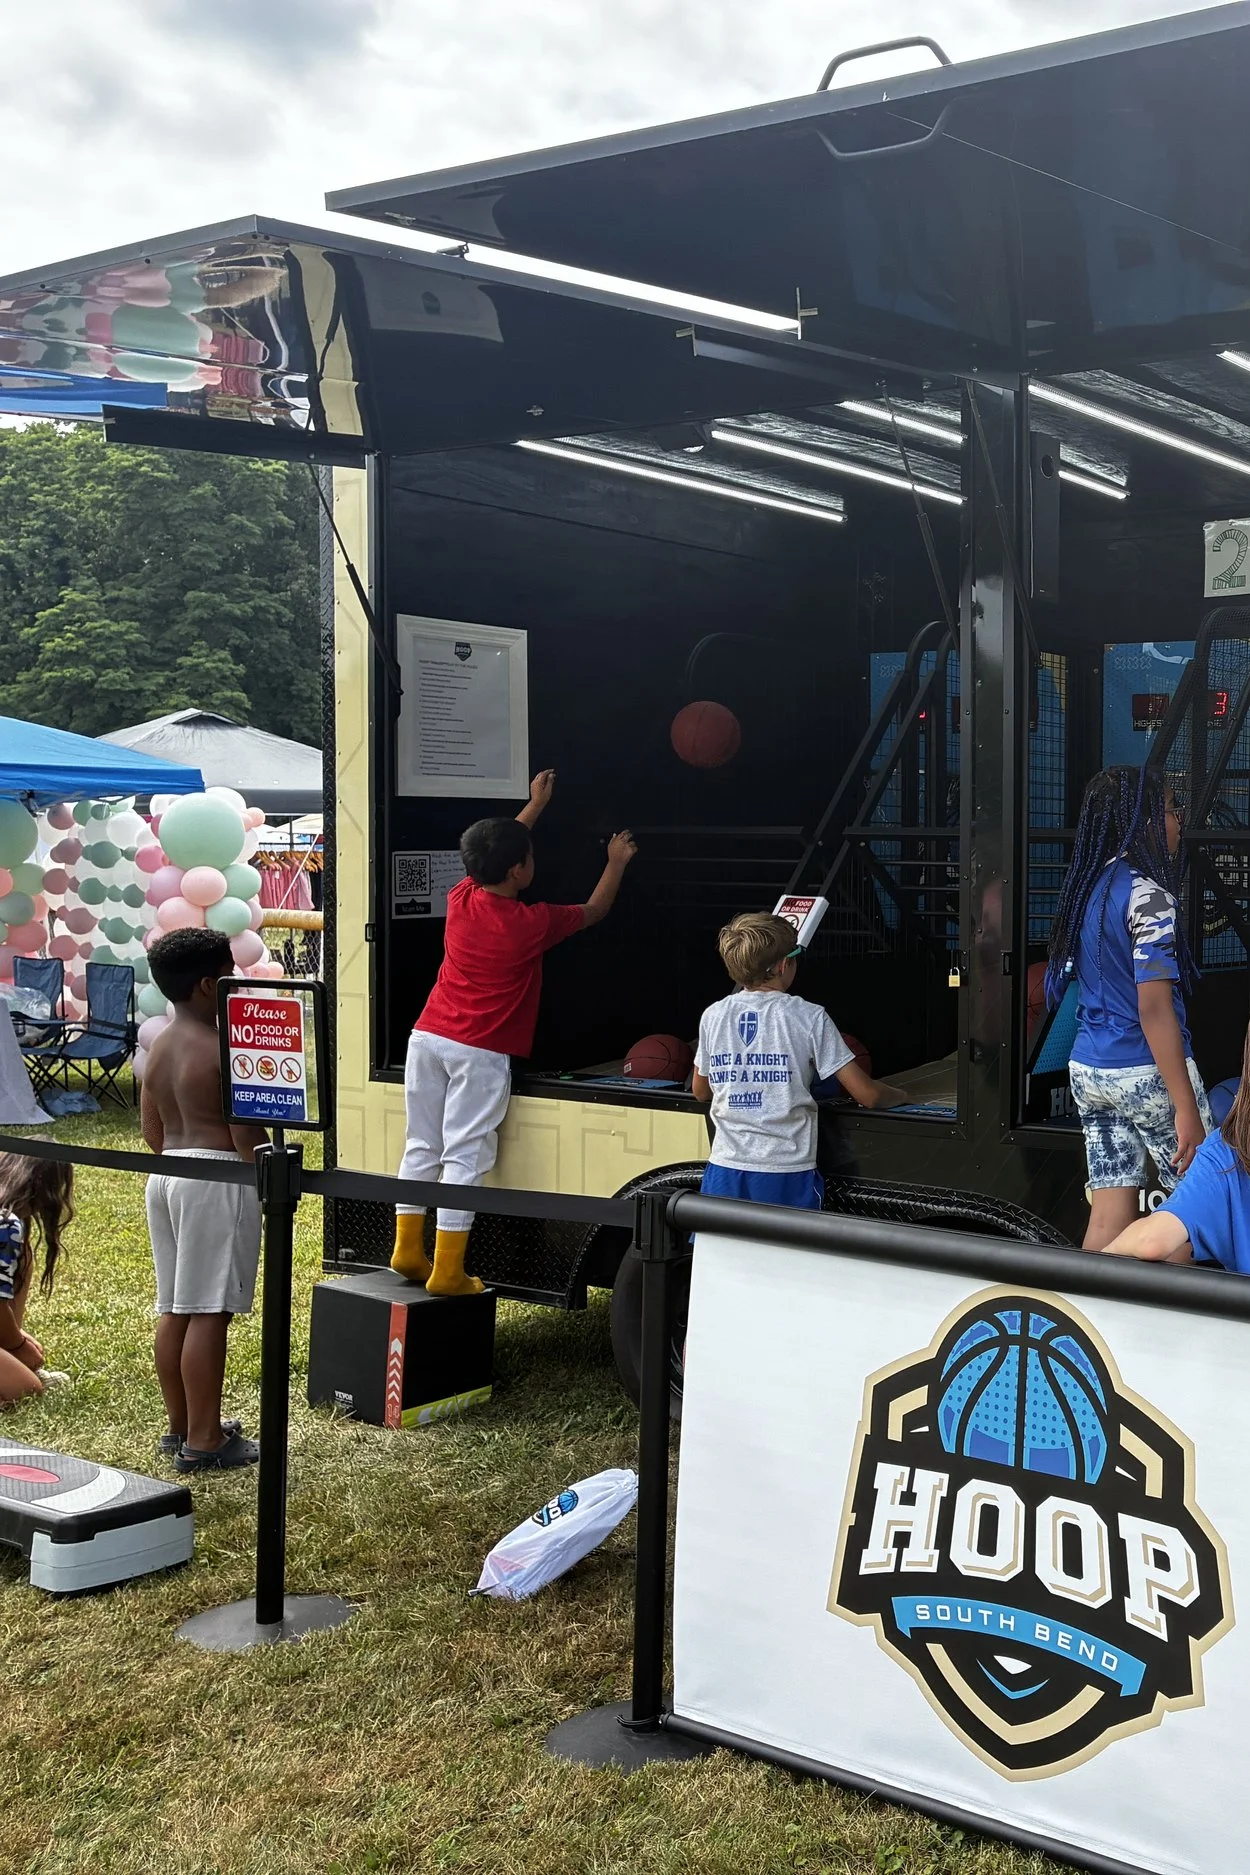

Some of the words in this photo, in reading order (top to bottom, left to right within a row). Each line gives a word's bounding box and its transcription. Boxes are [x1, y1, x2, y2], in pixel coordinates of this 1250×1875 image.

[1212, 528, 1248, 590] 2
[243, 1002, 288, 1020] Please
[231, 1023, 254, 1044] NO
[254, 1024, 282, 1036] FOOD
[284, 1026, 299, 1037] OR
[255, 1036, 292, 1048] DRINKS
[710, 1053, 731, 1067] ONCE
[734, 1053, 742, 1066] A
[746, 1053, 788, 1066] KNIGHT
[709, 1070, 737, 1084] ALWS
[740, 1070, 749, 1083] A
[752, 1070, 793, 1083] KNIGHT
[234, 1090, 255, 1102] KEEP
[255, 1092, 277, 1105] AREA
[277, 1094, 303, 1106] CLEAN
[858, 1462, 1201, 1642] HOOP
[916, 1603, 1016, 1632] SOUTH
[1034, 1621, 1118, 1673] BEND
